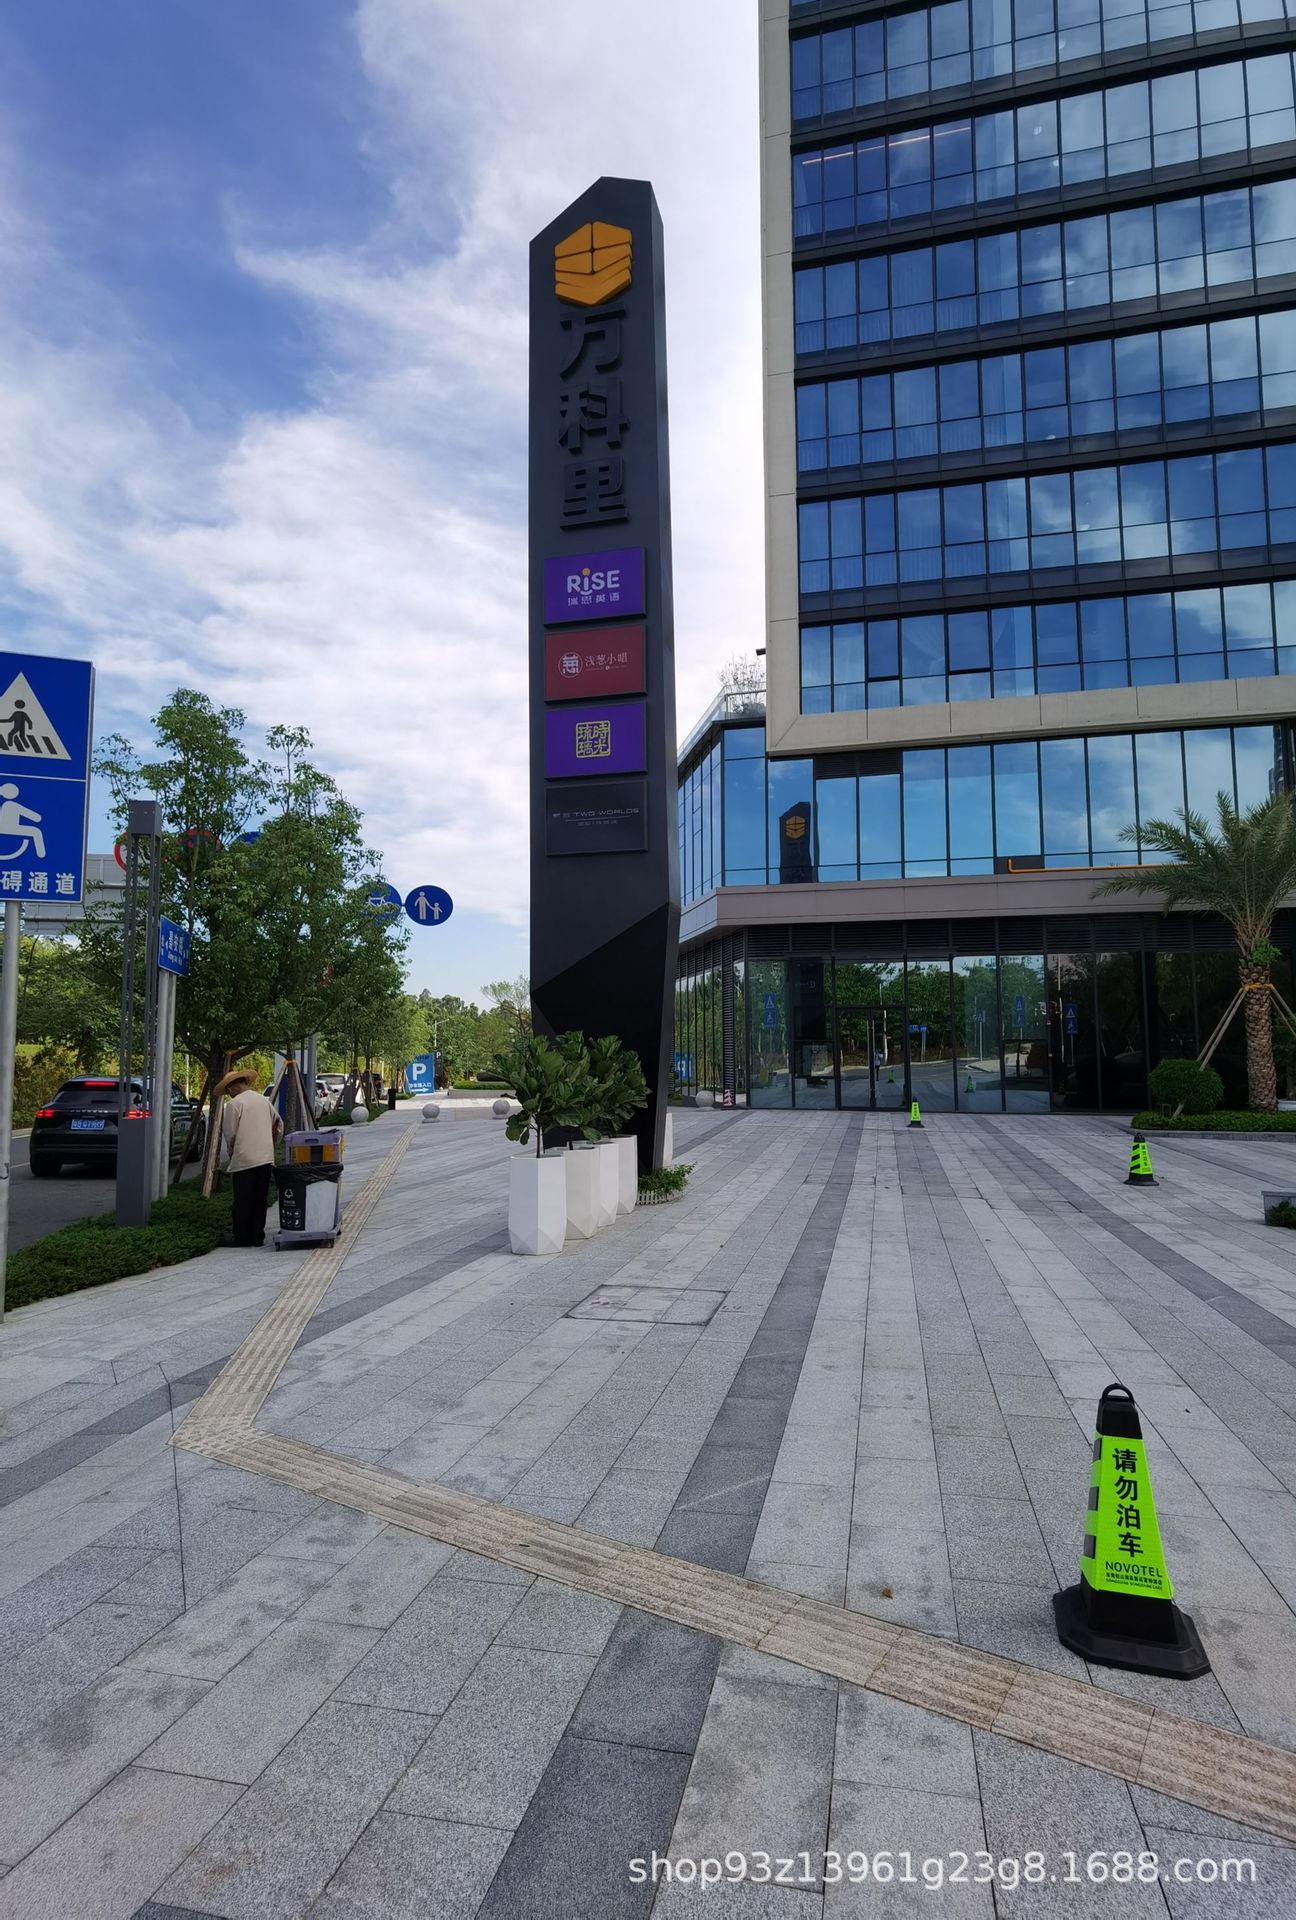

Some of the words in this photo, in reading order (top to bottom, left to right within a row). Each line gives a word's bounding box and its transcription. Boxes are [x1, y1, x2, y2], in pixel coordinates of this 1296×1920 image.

[559, 303, 630, 531] 万科里
[0, 870, 75, 895] 碍通道
[412, 1063, 427, 1081] P
[1112, 1447, 1144, 1558] 请勿泊车
[1105, 1560, 1163, 1578] NOVOTEL
